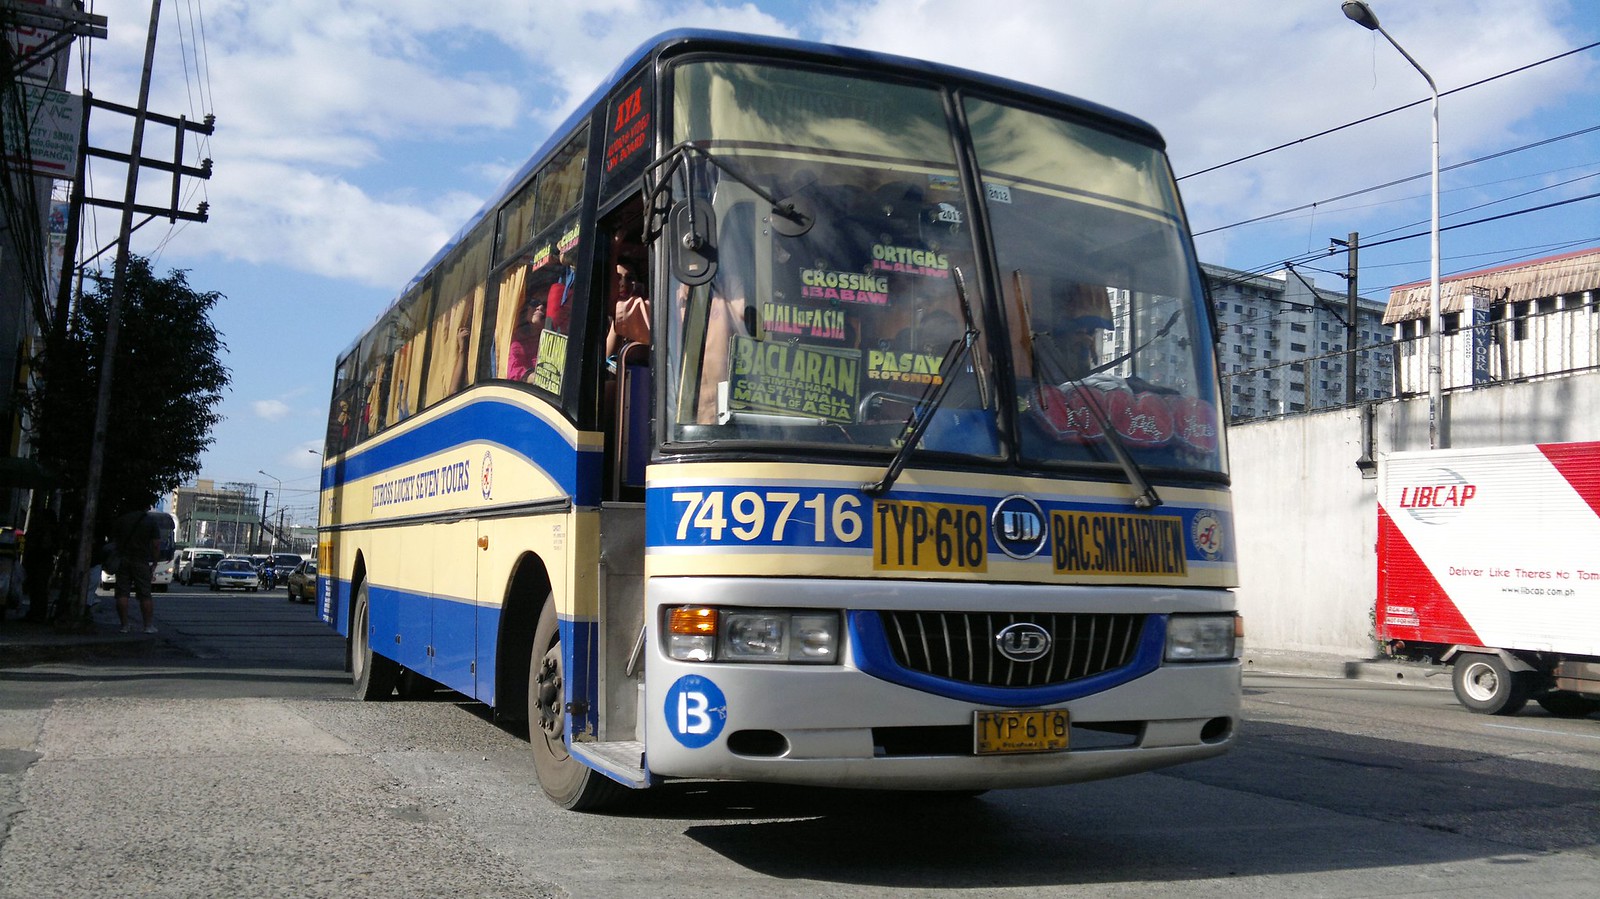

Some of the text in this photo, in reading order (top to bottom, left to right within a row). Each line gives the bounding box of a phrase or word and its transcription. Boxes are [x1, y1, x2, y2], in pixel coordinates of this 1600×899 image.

[614, 86, 642, 132] AYA
[988, 189, 1009, 201] 2012
[872, 244, 949, 270] ORTIGAS
[873, 259, 949, 279] ILALIM
[802, 269, 888, 294] CROSSING
[802, 286, 888, 304] IBABAW
[811, 307, 845, 340] ASIA
[735, 337, 857, 397] BACLARAN
[868, 350, 944, 375] PASAY
[1475, 338, 1488, 372] YORK
[737, 379, 850, 409] COASTAL MALL
[760, 375, 832, 395] SIMBAHAN
[734, 388, 851, 420] MALL OF ASIA
[394, 475, 415, 504] LUCKY
[416, 468, 440, 500] SEVEN
[441, 459, 470, 495] TOURS
[1400, 485, 1477, 508] LIBCAP
[672, 491, 863, 543] 749716
[1449, 566, 1484, 576] Deliver
[1490, 568, 1511, 577] Like
[1576, 570, 1600, 581] Tom
[1003, 631, 1045, 654] UD
[677, 691, 712, 734] B
[979, 711, 1065, 740] TYP 618
